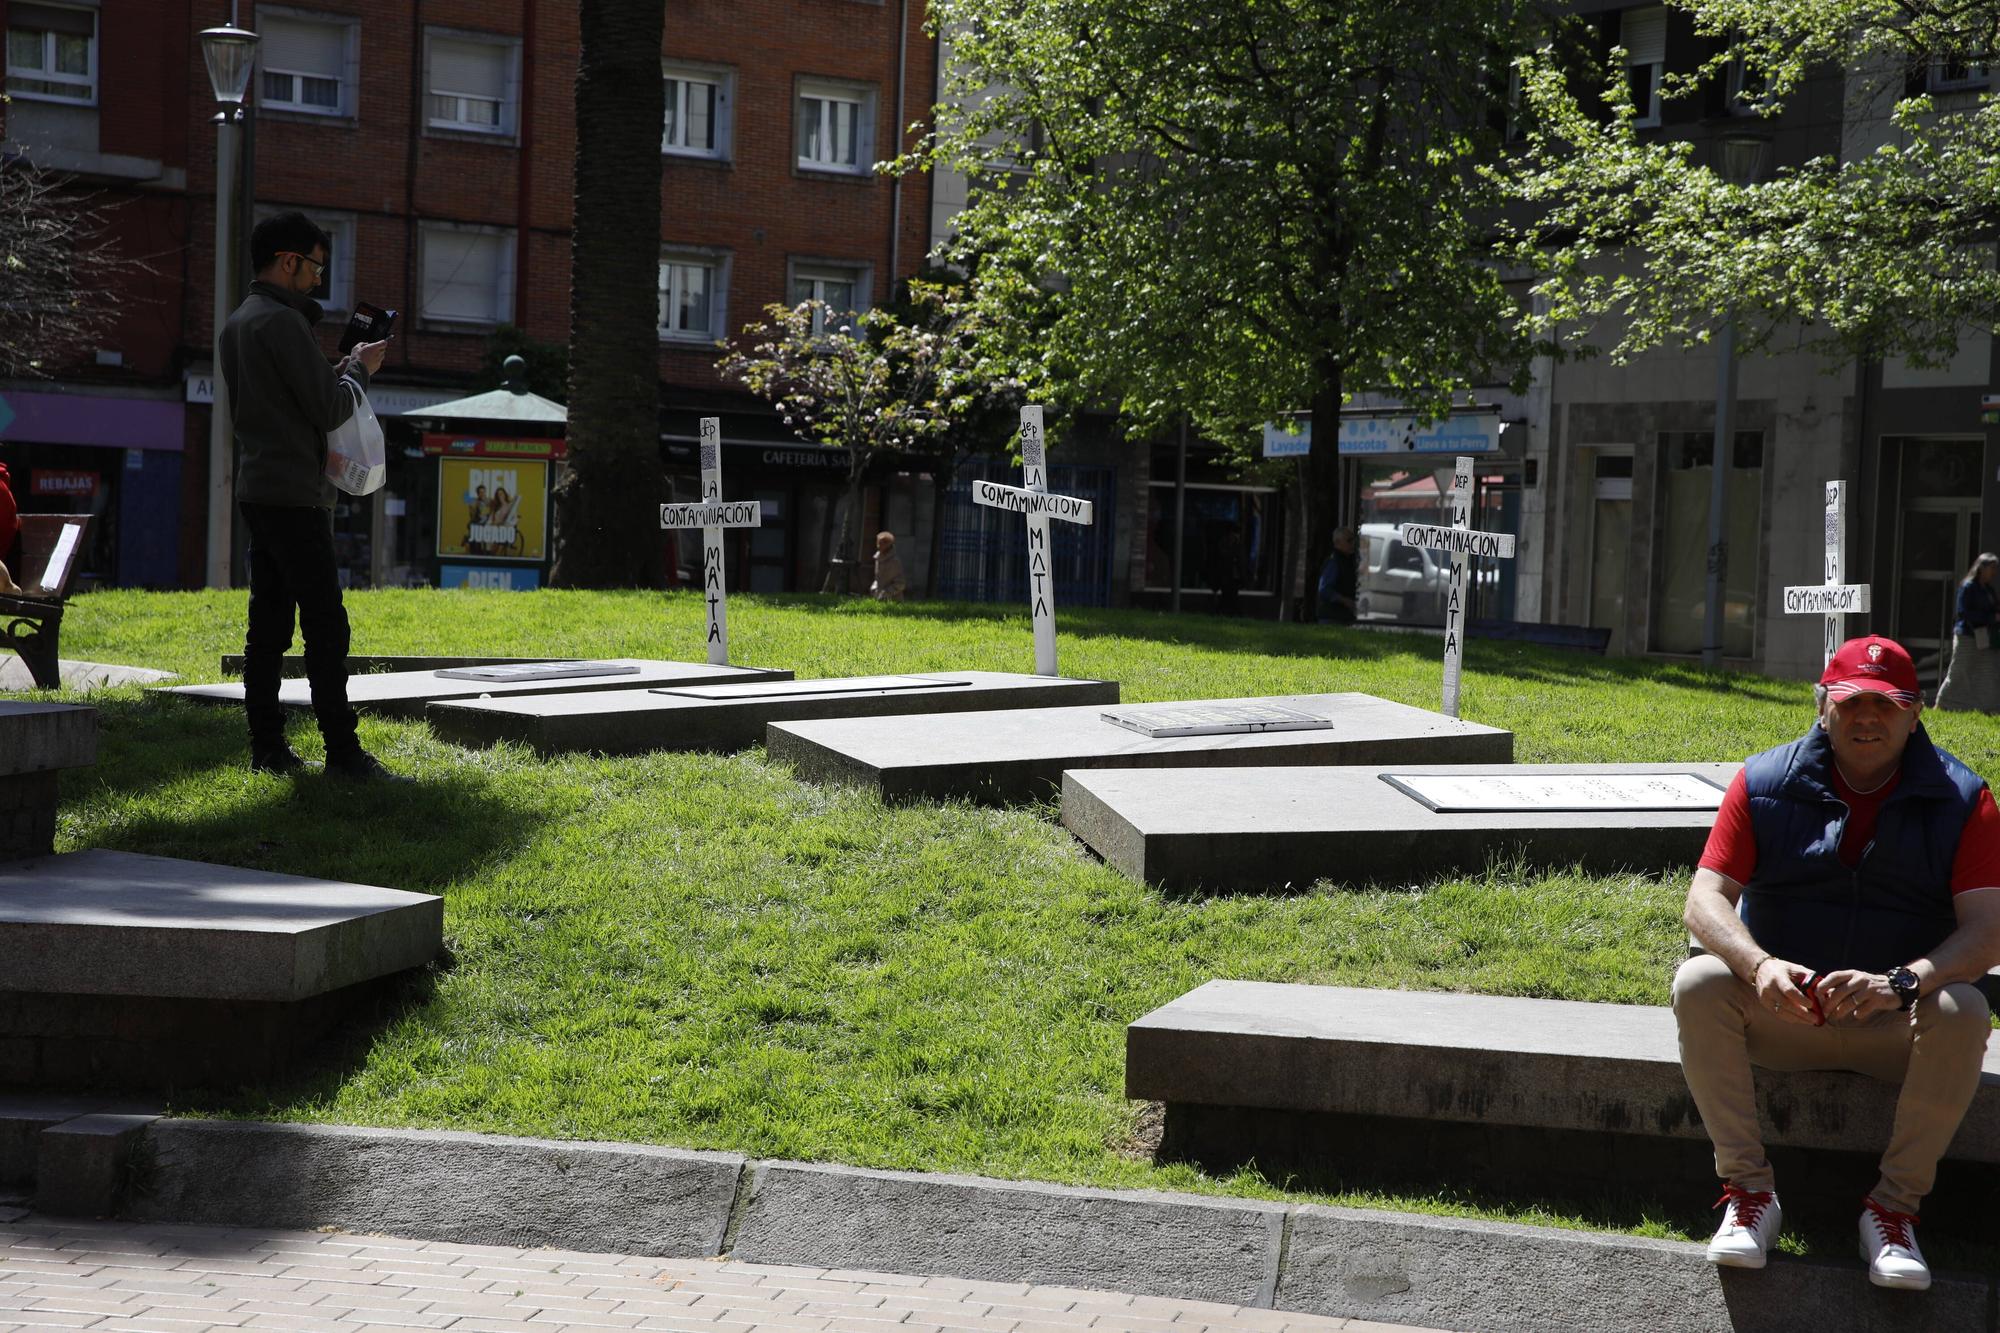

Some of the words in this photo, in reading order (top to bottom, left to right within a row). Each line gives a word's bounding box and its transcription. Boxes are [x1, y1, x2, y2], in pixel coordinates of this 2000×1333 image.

[40, 476, 93, 491] REBAJAS
[1024, 466, 1042, 486] LA
[1454, 474, 1469, 489] DEP
[702, 481, 718, 499] LA
[1454, 506, 1467, 528] LA
[1030, 527, 1048, 618] MATA
[1826, 556, 1838, 581] LA
[1445, 561, 1462, 656] MATA
